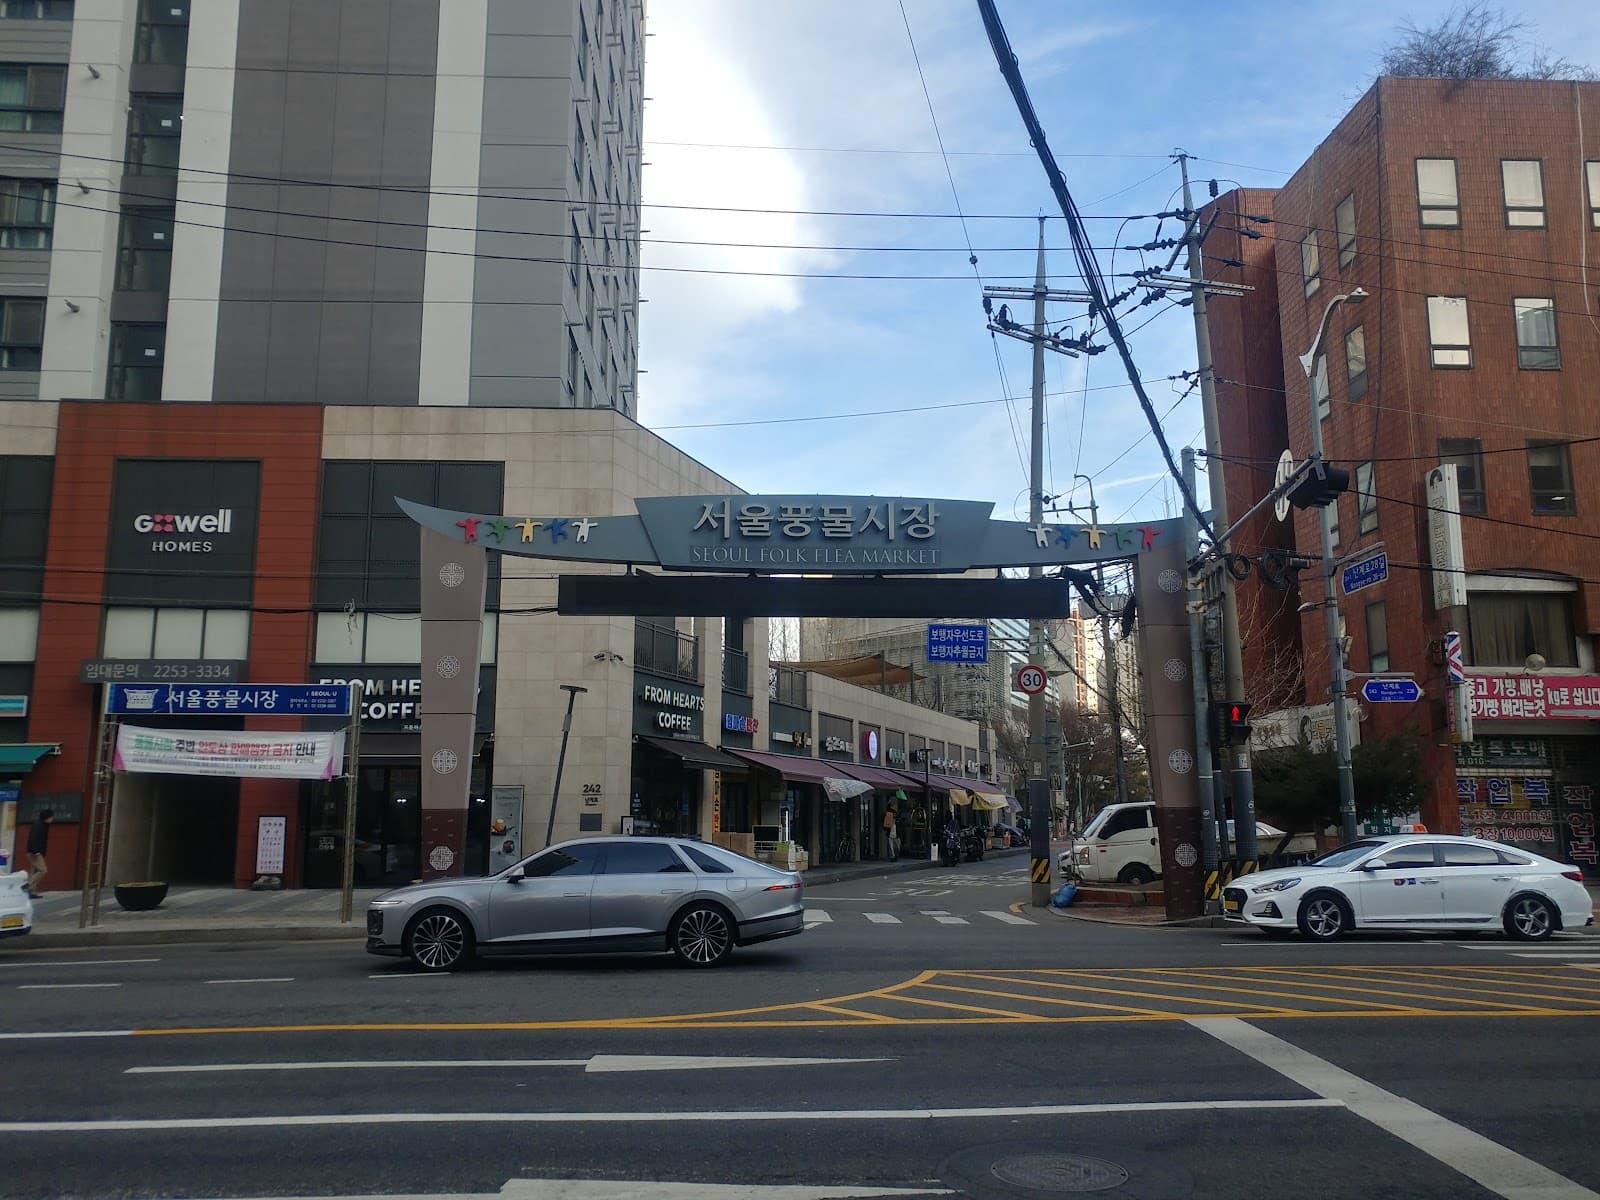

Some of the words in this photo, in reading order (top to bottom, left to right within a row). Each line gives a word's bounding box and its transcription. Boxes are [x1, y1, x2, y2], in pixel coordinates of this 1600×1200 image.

[693, 500, 939, 541] 서울풍물시장
[152, 541, 213, 552] HOMES
[692, 547, 752, 563] SEOUL
[760, 547, 808, 563] FOLK
[815, 548, 856, 564] FLEA
[862, 548, 940, 565] MARKET
[930, 629, 985, 642] 보행자우선도로
[930, 645, 984, 658] 보행자추월금지
[86, 664, 139, 679] 임대문의
[153, 665, 231, 678] 2253-3334
[1023, 673, 1042, 687] 30
[165, 689, 279, 709] 서울풍물시장
[644, 685, 671, 705] FROM
[672, 690, 705, 712] HEARTS
[1501, 698, 1546, 718] 버리는것
[658, 711, 692, 731] COFFEE
[175, 739, 195, 753] 주변
[272, 743, 293, 756] 금지
[295, 742, 316, 757] 안내
[583, 784, 601, 797] 242
[1501, 827, 1555, 842] 10,000원
